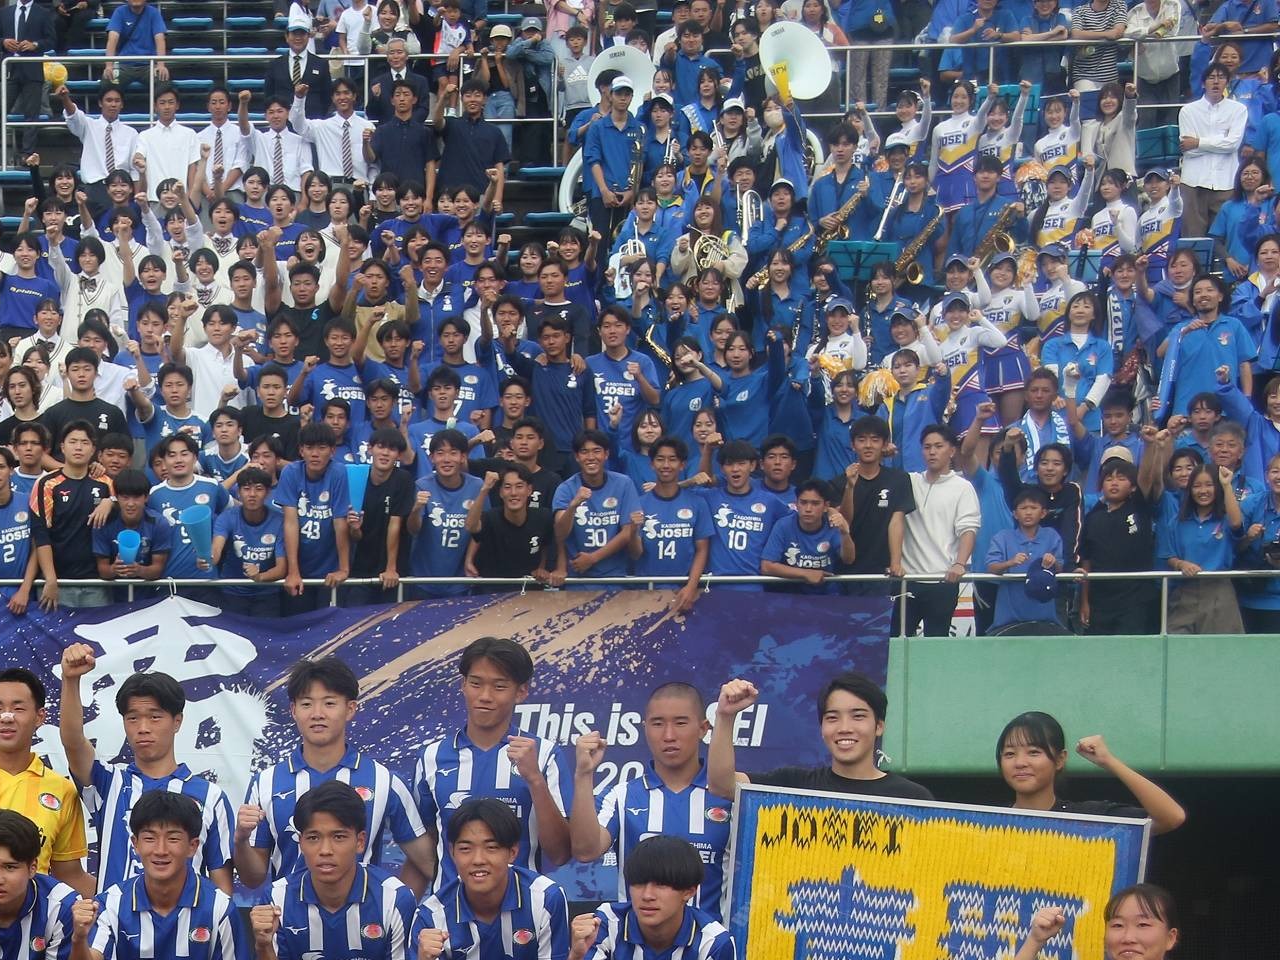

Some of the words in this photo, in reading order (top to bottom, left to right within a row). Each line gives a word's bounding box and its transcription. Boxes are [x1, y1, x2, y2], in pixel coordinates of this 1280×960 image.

[602, 386, 635, 396] JOSEI
[300, 520, 321, 539] 43
[586, 515, 620, 527] JOSEI
[729, 519, 764, 532] JOSEI
[0, 528, 31, 544] JOSEI
[442, 529, 460, 548] 12
[584, 529, 607, 547] 30
[656, 528, 693, 539] JOSEI
[728, 531, 747, 551] 10
[3, 544, 15, 563] 2
[657, 541, 676, 560] 14
[514, 703, 595, 747] This
[607, 703, 641, 747] is
[761, 808, 906, 856] JOSEI
